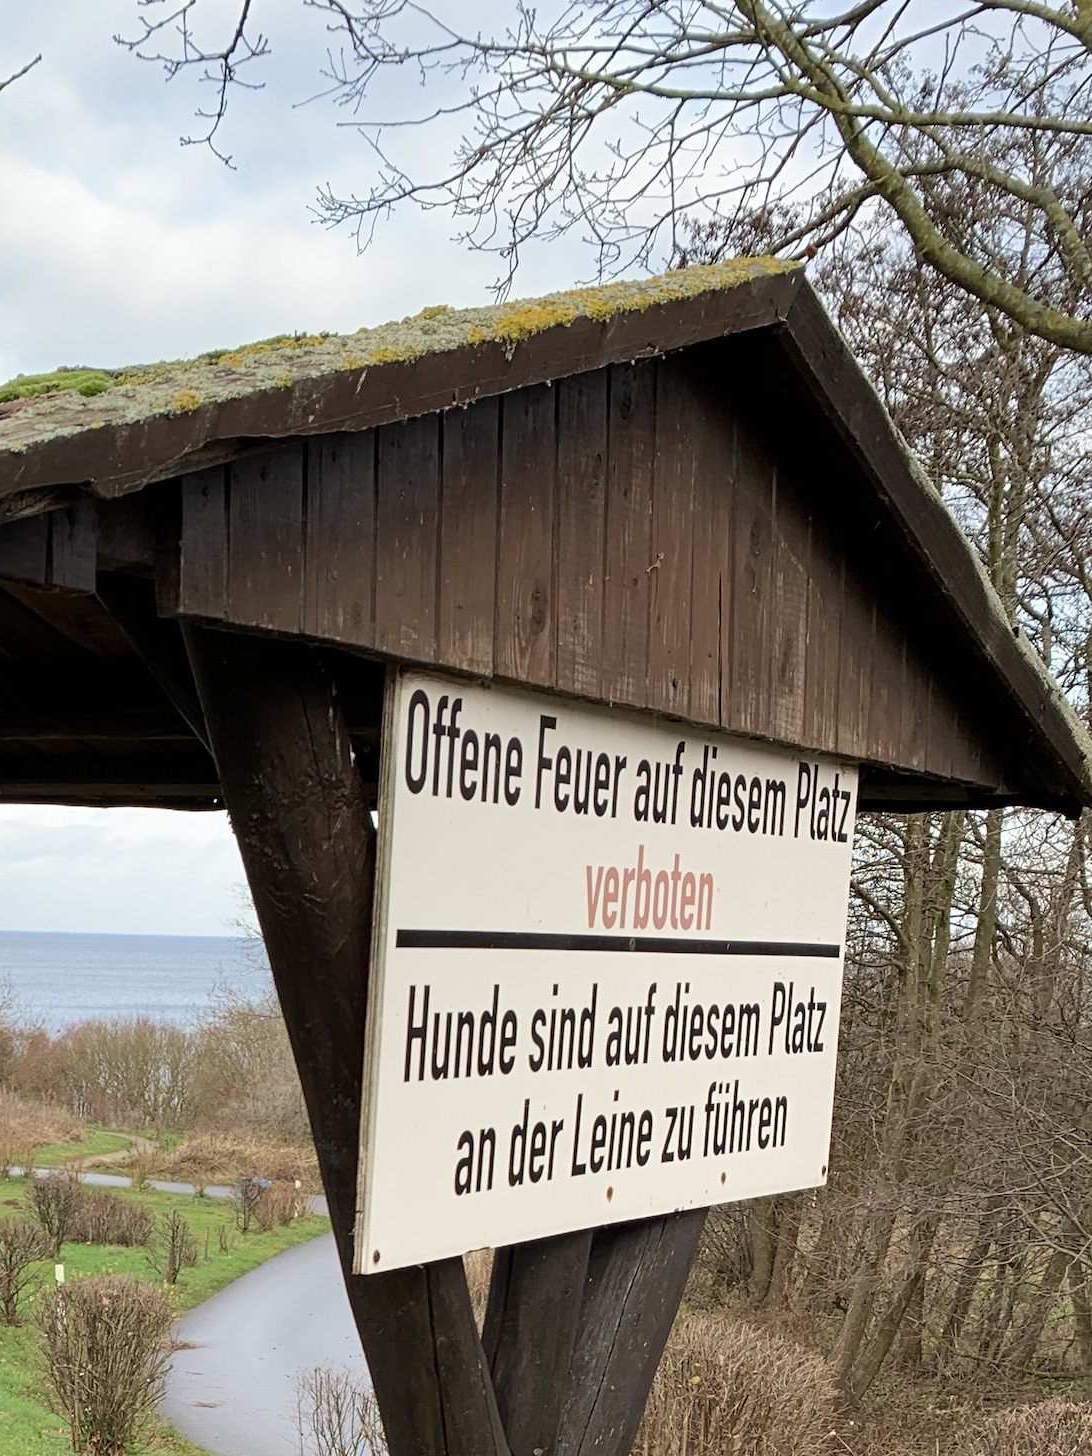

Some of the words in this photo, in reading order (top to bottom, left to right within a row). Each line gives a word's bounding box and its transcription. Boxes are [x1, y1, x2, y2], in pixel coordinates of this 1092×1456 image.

[405, 688, 523, 806] Offene
[535, 715, 627, 818] Feuer
[634, 741, 686, 824] auf
[689, 745, 786, 836] diesem
[794, 762, 851, 842] Platz
[587, 845, 713, 930] verboten
[404, 985, 517, 1082] Hunde
[529, 984, 597, 1072] sind
[606, 983, 656, 1066] auf
[663, 983, 760, 1062] diesem
[769, 982, 826, 1055] Platz
[455, 1128, 495, 1195] an
[509, 1099, 563, 1186] der
[571, 1091, 652, 1176] Leine
[662, 1106, 694, 1163] zu
[704, 1080, 787, 1157] führen
